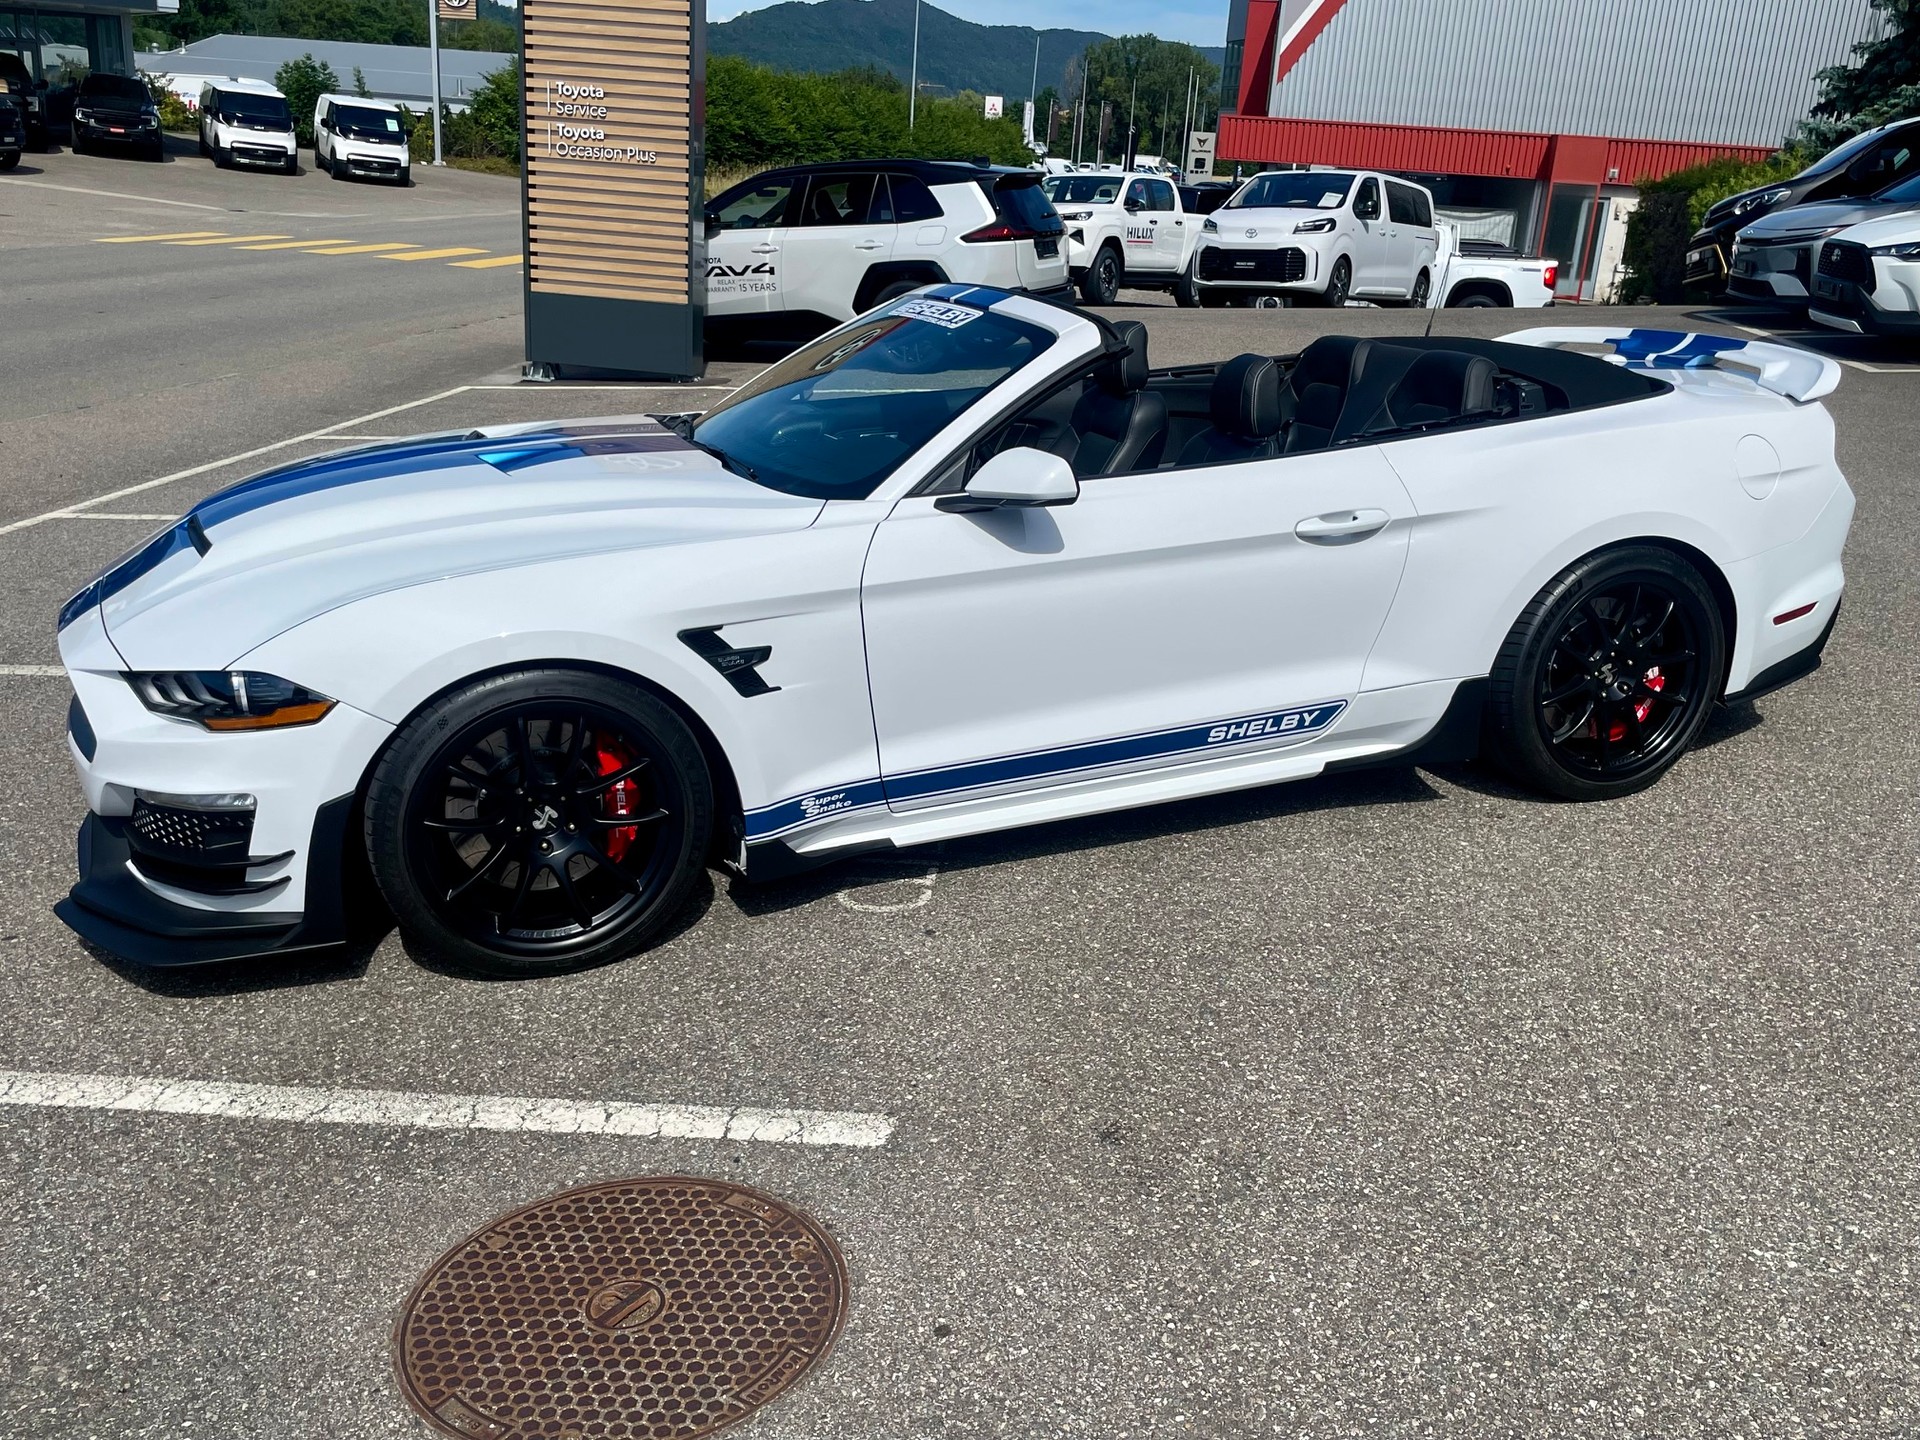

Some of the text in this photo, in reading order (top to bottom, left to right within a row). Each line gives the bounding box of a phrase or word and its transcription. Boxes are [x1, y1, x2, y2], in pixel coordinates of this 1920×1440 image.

[556, 82, 604, 99] Toyota
[556, 101, 607, 116] Service
[556, 124, 604, 140] Toyota
[556, 142, 657, 162] Occasion Plus
[1127, 227, 1154, 239] HILUX
[704, 263, 776, 277] AV4
[739, 283, 777, 292] 15 YEARS
[1207, 711, 1320, 742] SHELBY
[800, 792, 846, 809] Super
[805, 800, 852, 817] Snake
